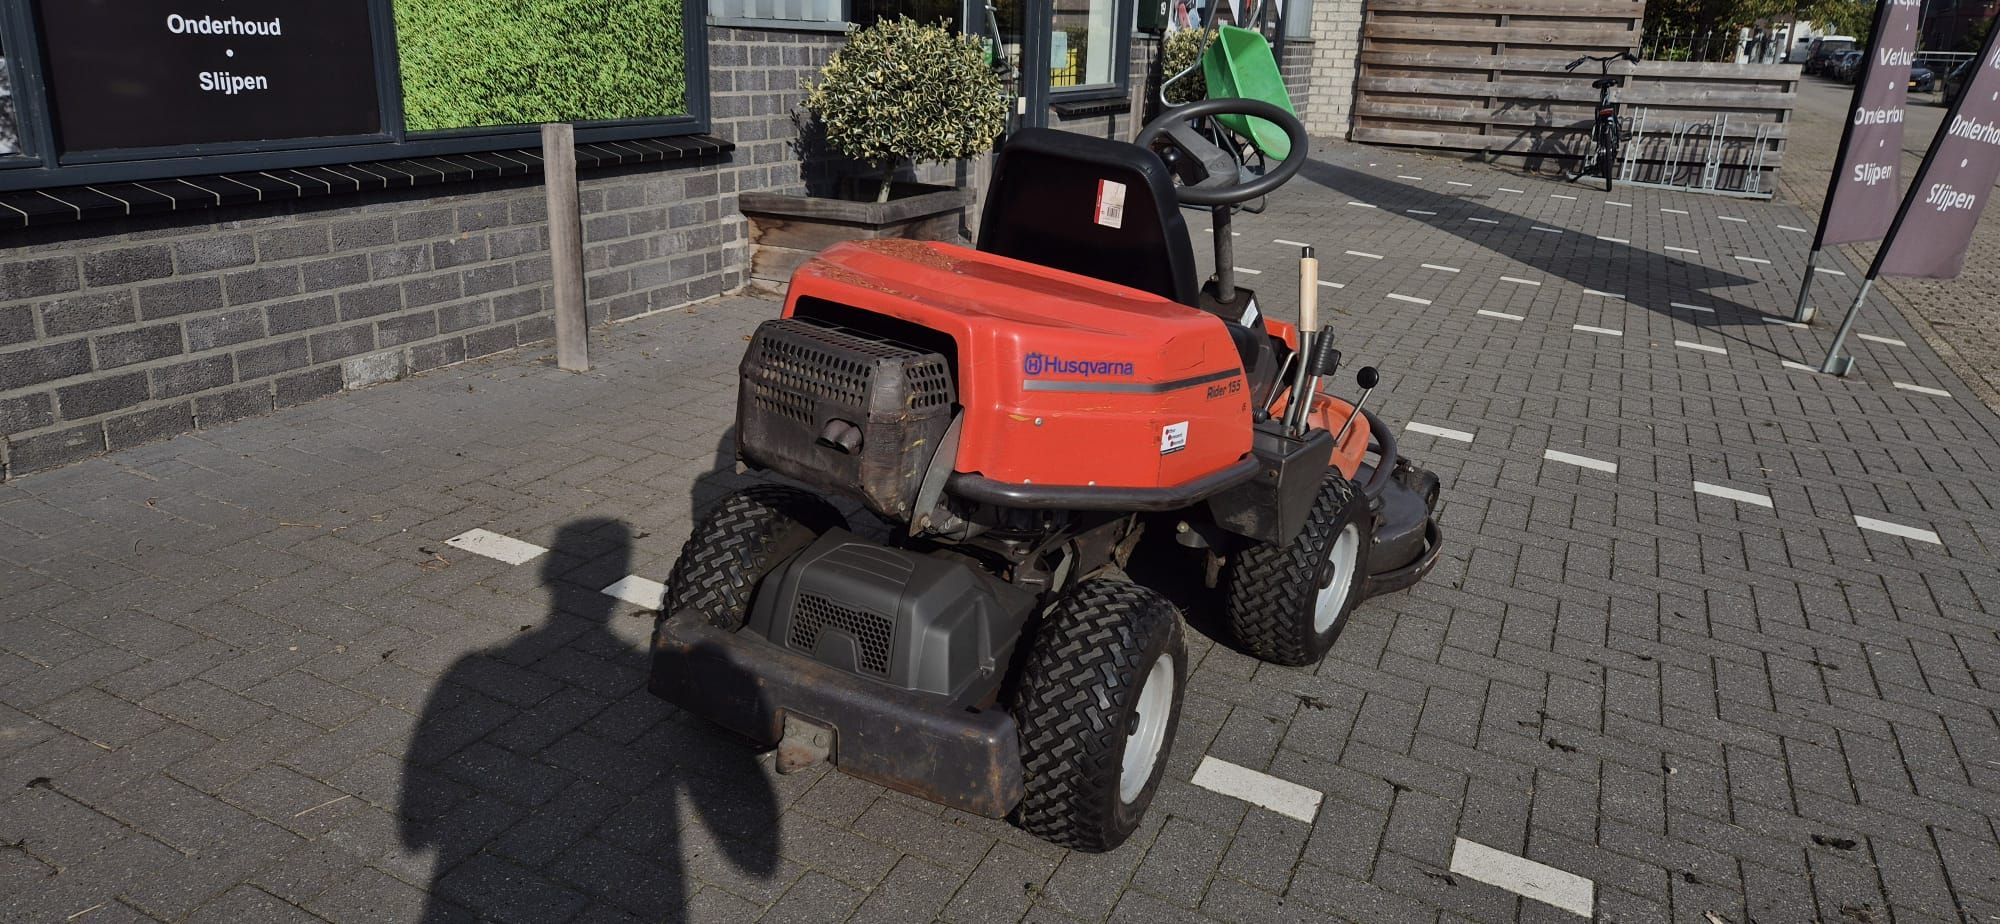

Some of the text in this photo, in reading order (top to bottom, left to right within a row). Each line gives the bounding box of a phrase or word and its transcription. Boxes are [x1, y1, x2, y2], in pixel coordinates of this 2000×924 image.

[167, 14, 281, 35] Onderhoud
[199, 72, 268, 94] Slijpen
[1949, 114, 2000, 145] Onderho
[1854, 163, 1893, 186] Slijpen
[1926, 183, 1976, 212] Slijpen
[1045, 356, 1134, 376] Husqvarna
[1207, 379, 1241, 400] Rider 155
